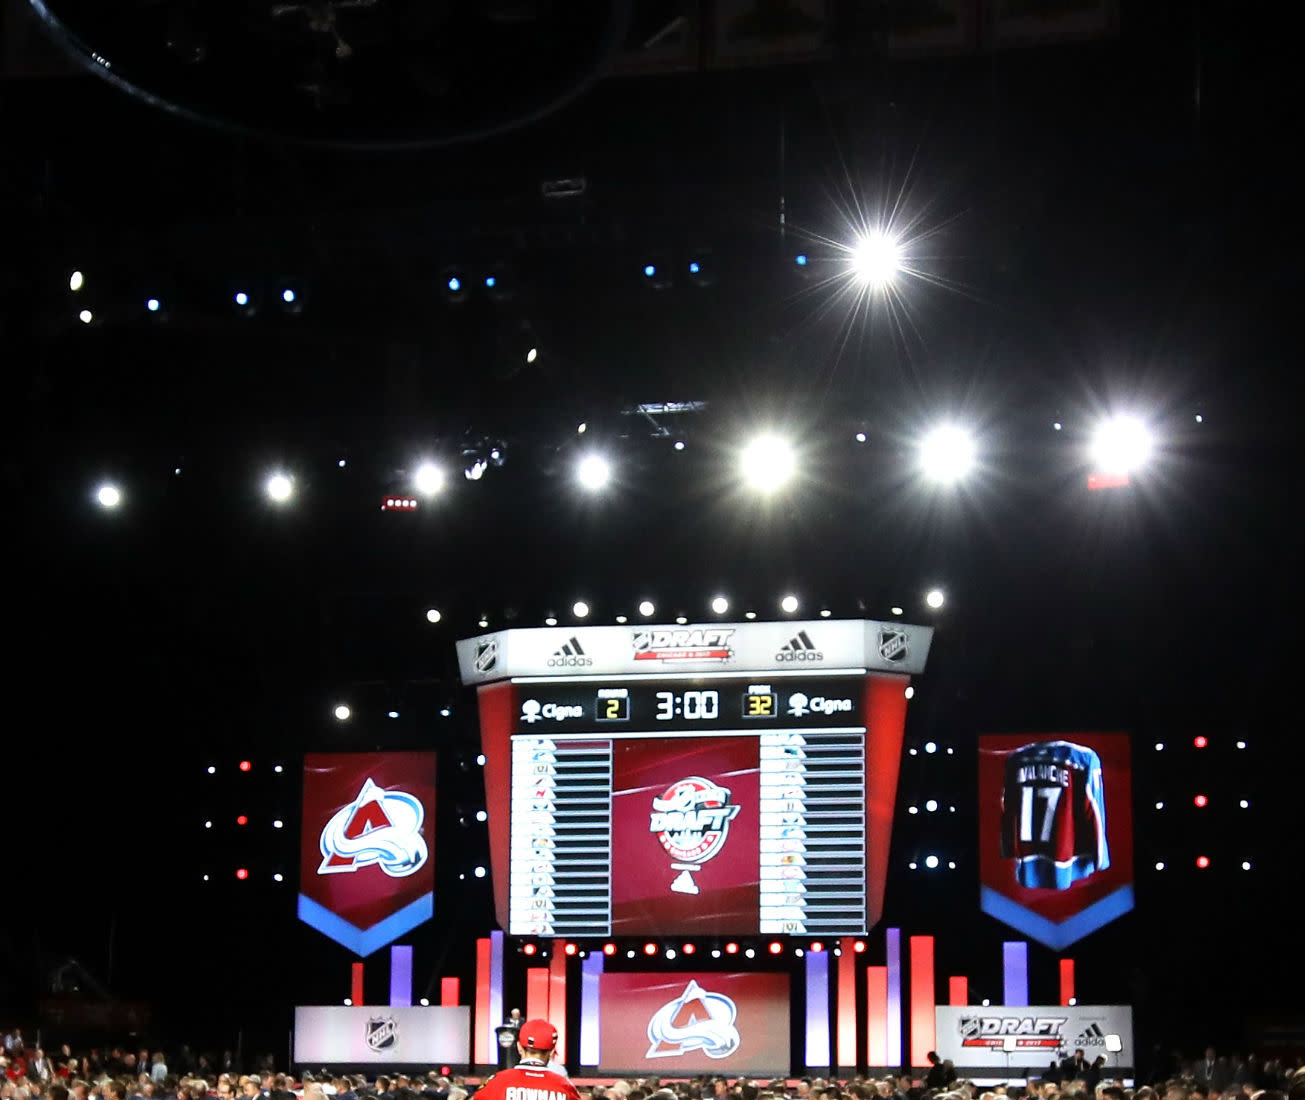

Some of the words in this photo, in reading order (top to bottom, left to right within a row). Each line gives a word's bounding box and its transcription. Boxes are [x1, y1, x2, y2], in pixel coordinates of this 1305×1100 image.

[652, 628, 736, 648] DRAFT
[547, 655, 593, 668] adidas
[775, 649, 823, 662] adidas
[542, 703, 583, 721] Cigna
[606, 699, 620, 718] 2
[656, 691, 719, 719] 3:00
[748, 695, 772, 715] 32
[809, 696, 852, 714] Cigna
[650, 805, 742, 832] DRAFT
[1020, 786, 1062, 841] 17
[981, 1017, 1067, 1035] DRAFT
